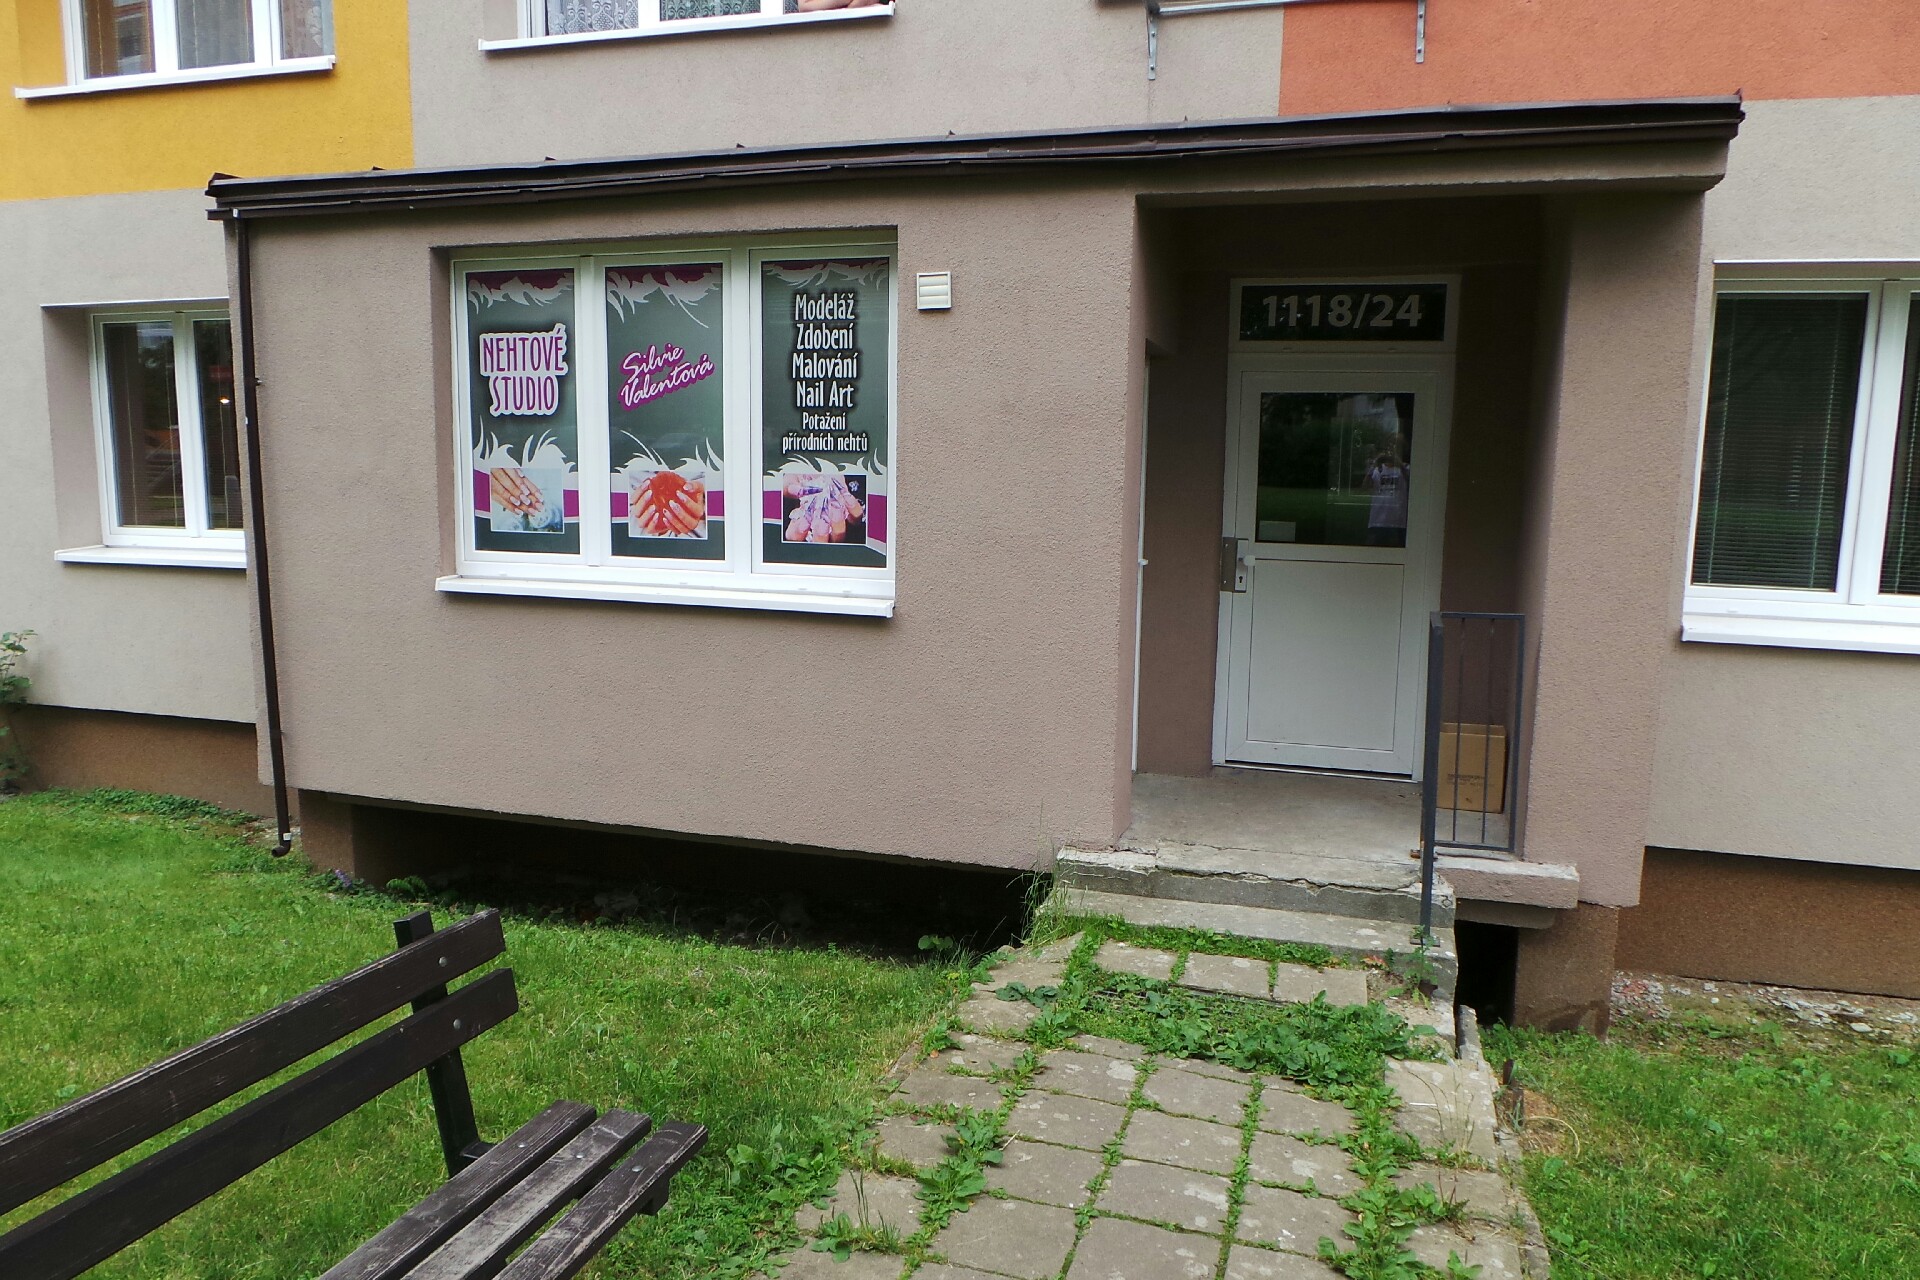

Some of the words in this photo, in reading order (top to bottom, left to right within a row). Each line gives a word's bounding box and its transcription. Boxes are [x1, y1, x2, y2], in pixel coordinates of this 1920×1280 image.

[794, 292, 856, 321] Modeláž
[1262, 293, 1423, 329] 1118/24
[482, 327, 565, 373] NEHTOVÉ
[796, 322, 854, 350] Zdobení
[622, 343, 684, 384] Silvie
[792, 352, 859, 379] Malování
[492, 375, 555, 412] STUDIO
[620, 354, 714, 407] Valentová
[796, 380, 824, 408] Nail
[828, 380, 855, 408] Art
[802, 411, 847, 430] Potažení
[782, 432, 834, 455] přírodních
[837, 432, 868, 452] nehtů
